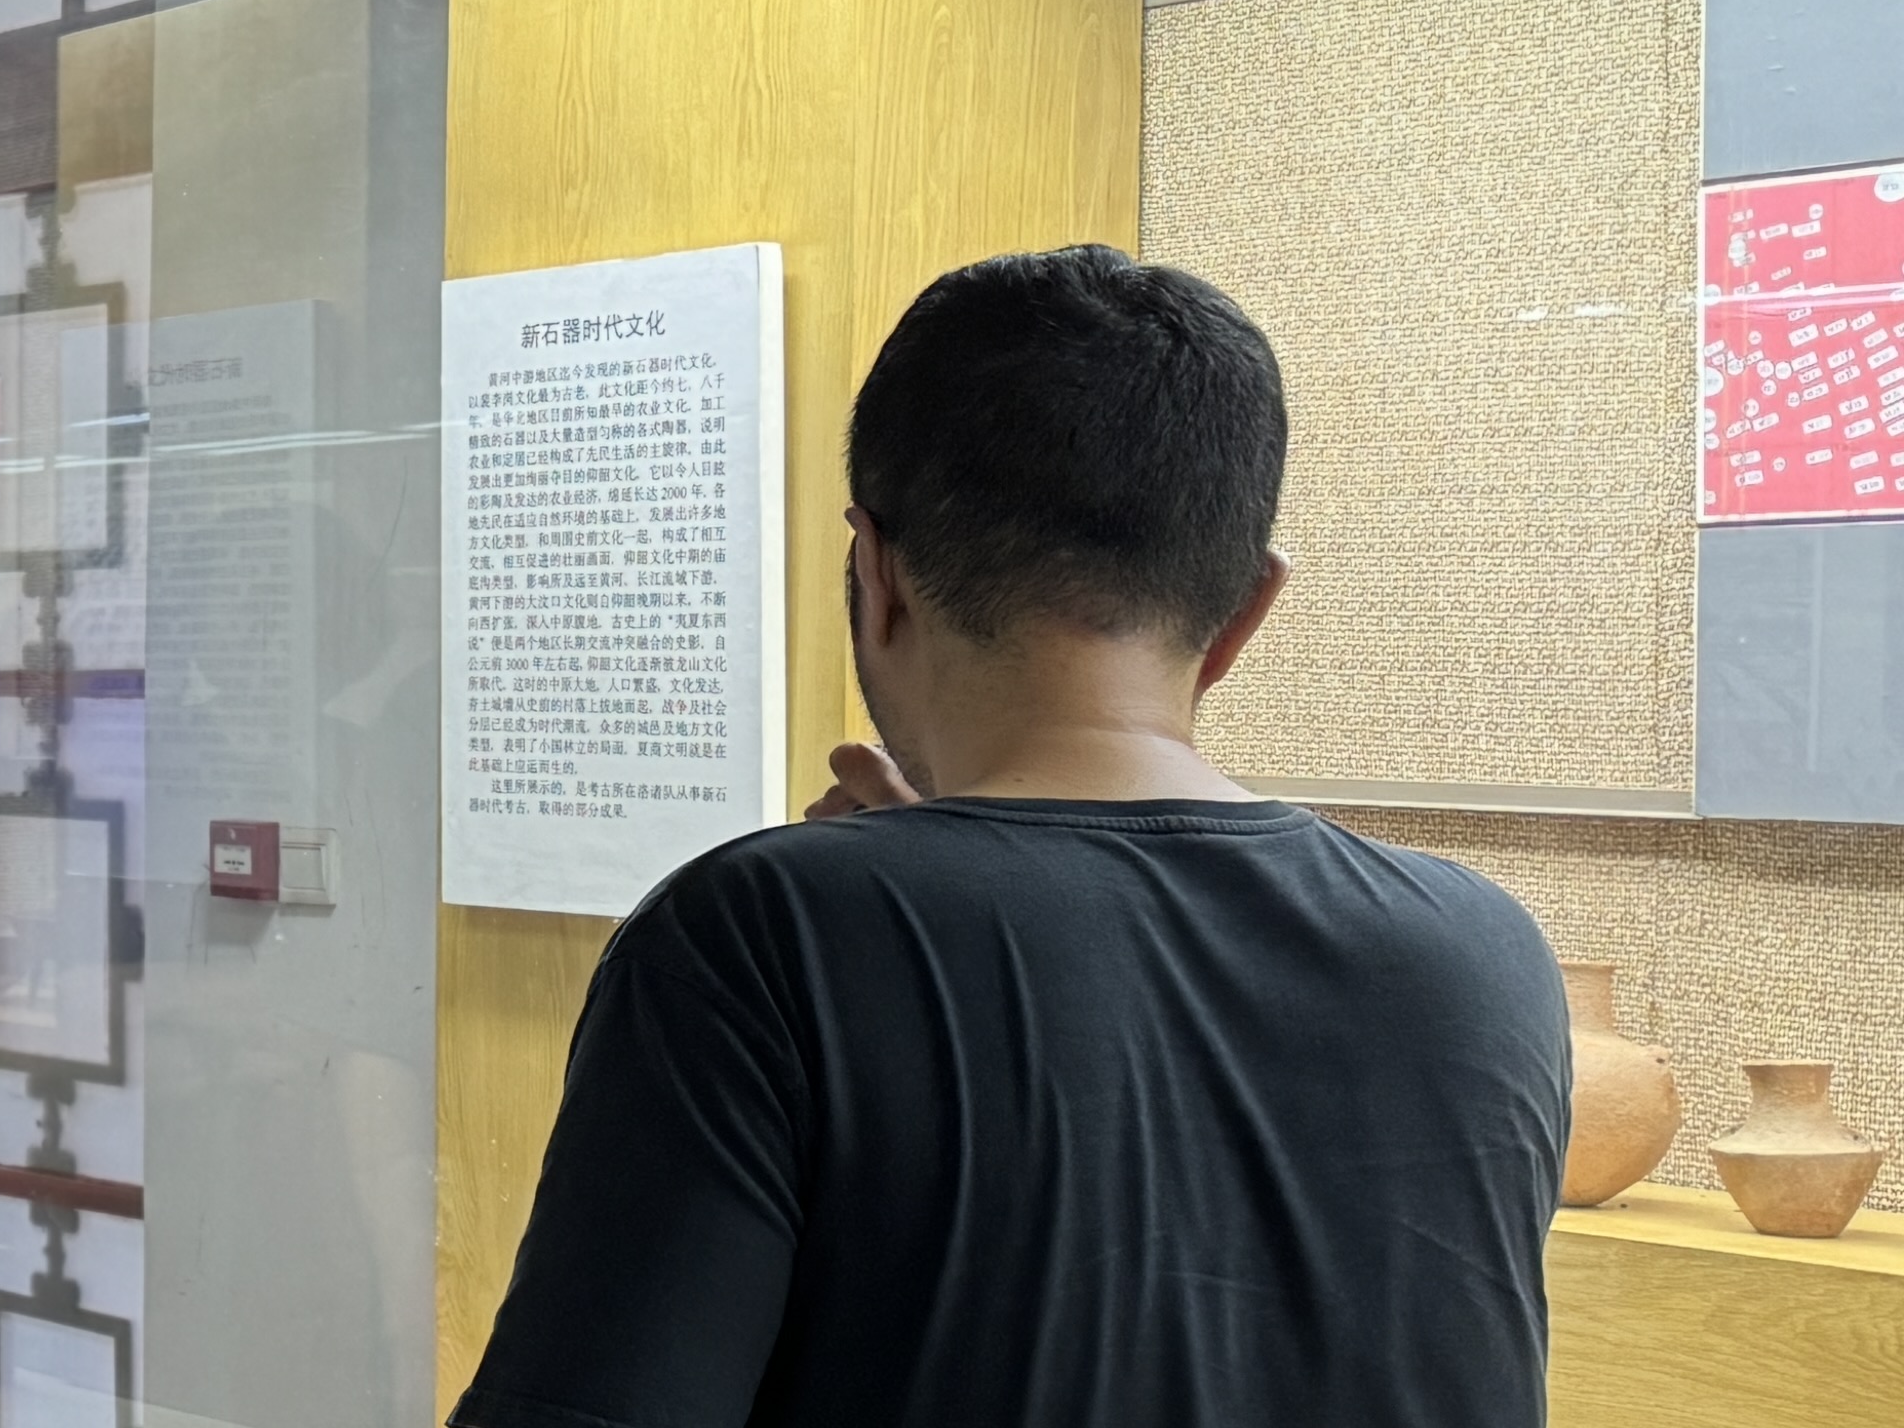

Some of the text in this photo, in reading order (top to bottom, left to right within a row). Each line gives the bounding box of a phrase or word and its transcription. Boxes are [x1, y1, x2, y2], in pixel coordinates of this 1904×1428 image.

[520, 309, 666, 349] 新石器时代文化
